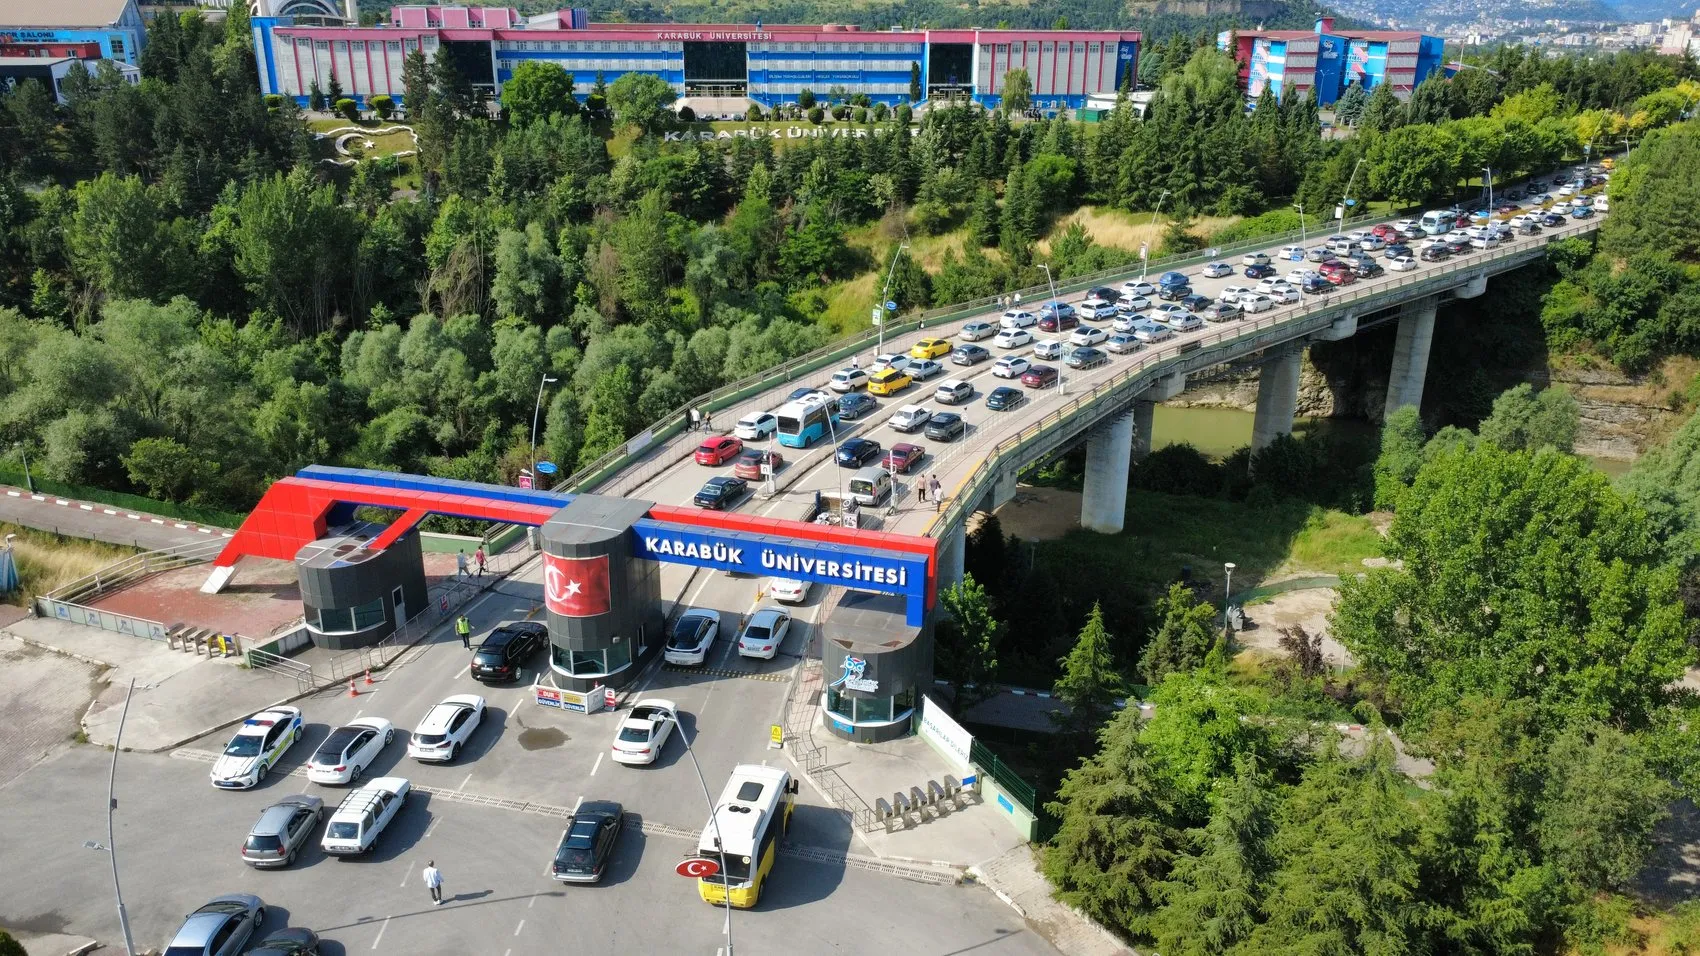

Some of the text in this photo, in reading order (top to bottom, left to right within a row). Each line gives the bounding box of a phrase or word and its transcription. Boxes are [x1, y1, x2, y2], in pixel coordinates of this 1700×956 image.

[710, 32, 772, 40] ÜNİVERSİTESİ
[645, 536, 907, 586] KARABÜK ÜNİVERSİTESİ
[542, 690, 555, 698] DUR
